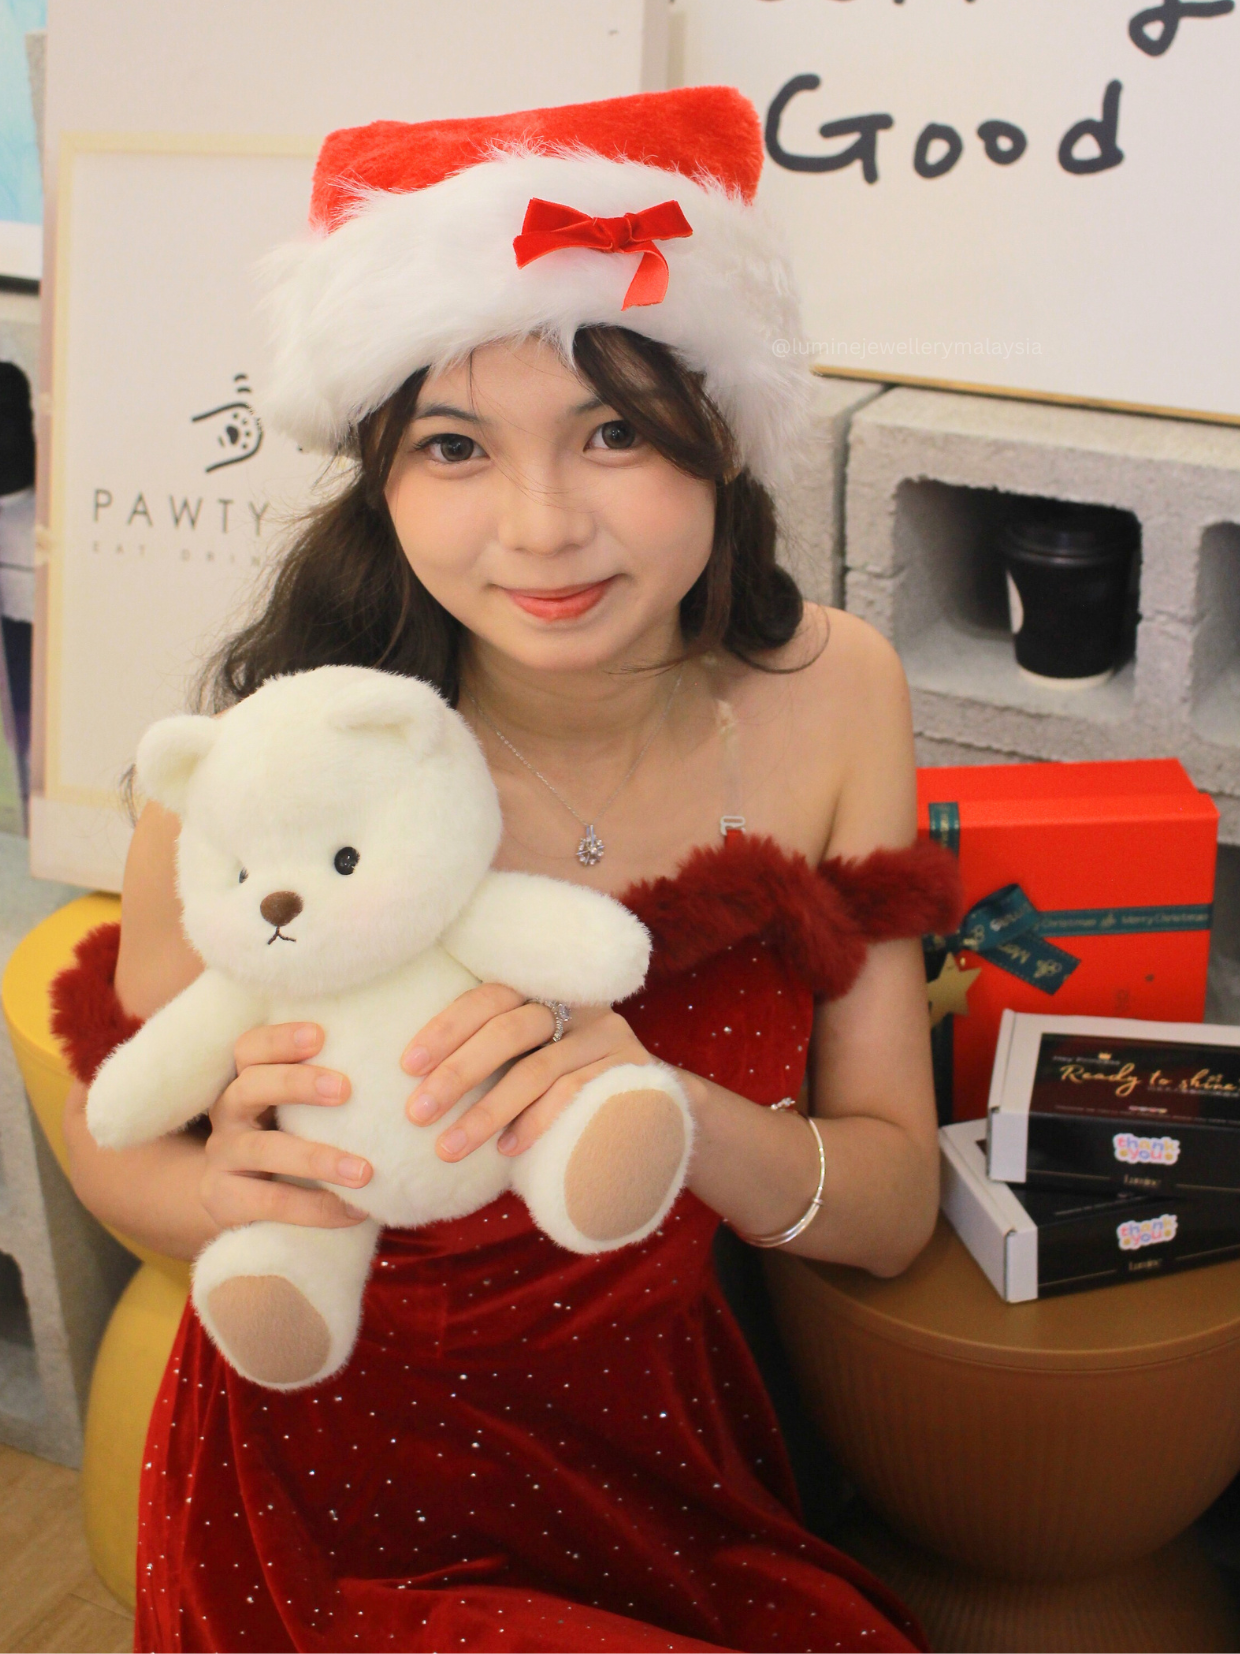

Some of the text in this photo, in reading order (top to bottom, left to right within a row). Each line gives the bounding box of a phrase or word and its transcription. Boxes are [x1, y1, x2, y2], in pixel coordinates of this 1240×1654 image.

[765, 73, 1124, 184] Good
[92, 488, 270, 536] PAWTY
[1060, 1062, 1141, 1097] Ready
[1149, 1069, 1171, 1086] to
[1117, 1136, 1176, 1152] thank
[1127, 1147, 1163, 1161] you
[1120, 1216, 1173, 1237] thank
[1132, 1230, 1163, 1246] you
